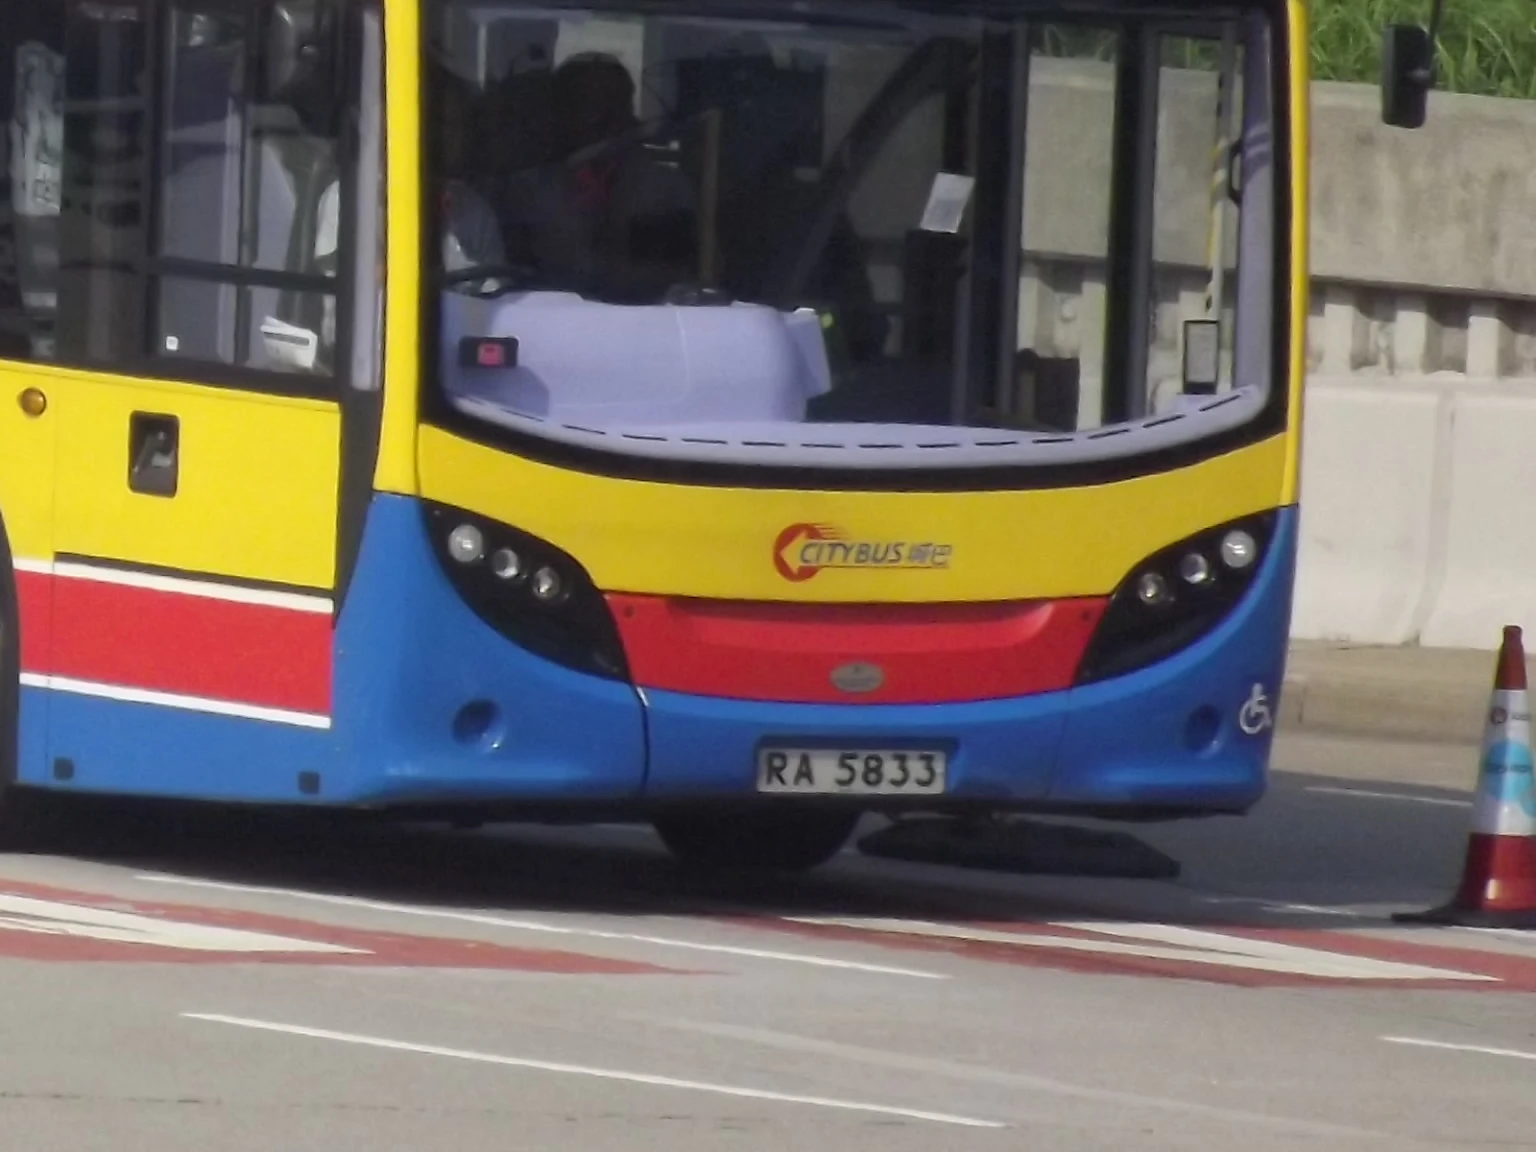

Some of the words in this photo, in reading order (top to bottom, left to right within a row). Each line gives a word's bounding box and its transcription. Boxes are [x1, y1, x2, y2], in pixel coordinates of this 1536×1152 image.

[799, 541, 905, 565] CITYBUS
[765, 753, 816, 786] RA
[834, 753, 936, 787] 5833
